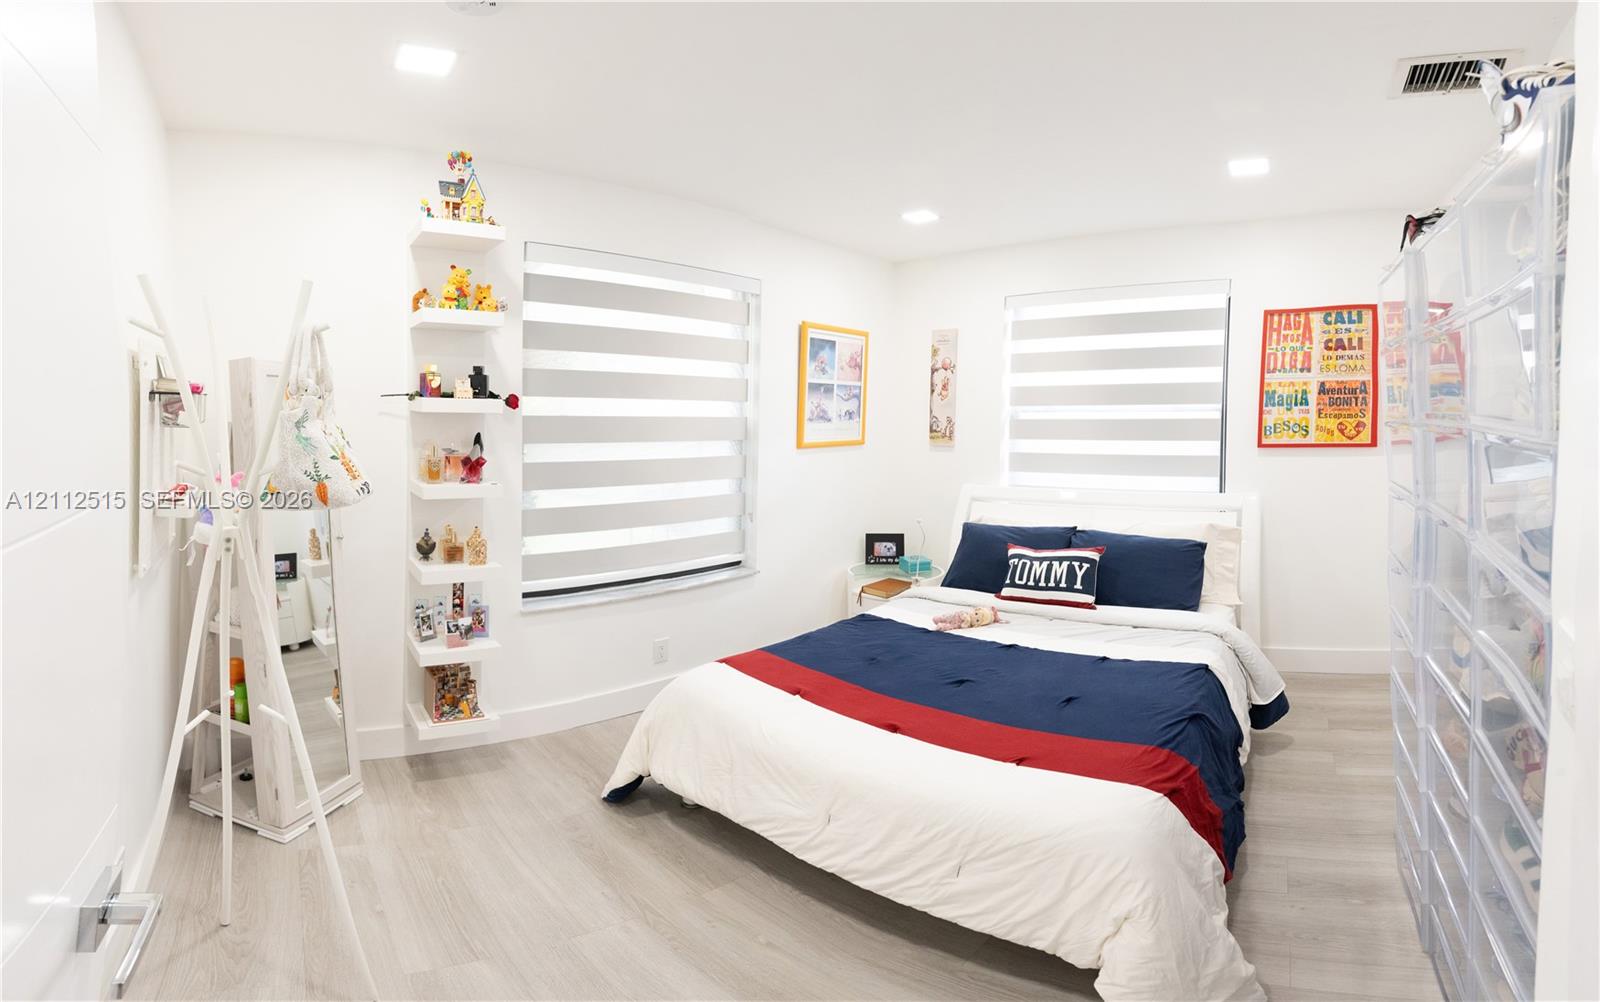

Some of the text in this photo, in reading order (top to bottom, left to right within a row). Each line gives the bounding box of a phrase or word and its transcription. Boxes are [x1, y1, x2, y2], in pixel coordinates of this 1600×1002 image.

[1323, 310, 1363, 325] CALI
[1323, 337, 1363, 351] CALI
[1267, 351, 1312, 369] DIGA
[1320, 364, 1367, 372] ES LOMA
[1318, 381, 1368, 395] AventurA
[1264, 388, 1309, 412] MagiA
[1328, 396, 1367, 407] BONITA
[1264, 420, 1309, 436] BESOS
[1005, 558, 1090, 590] TOMMY
